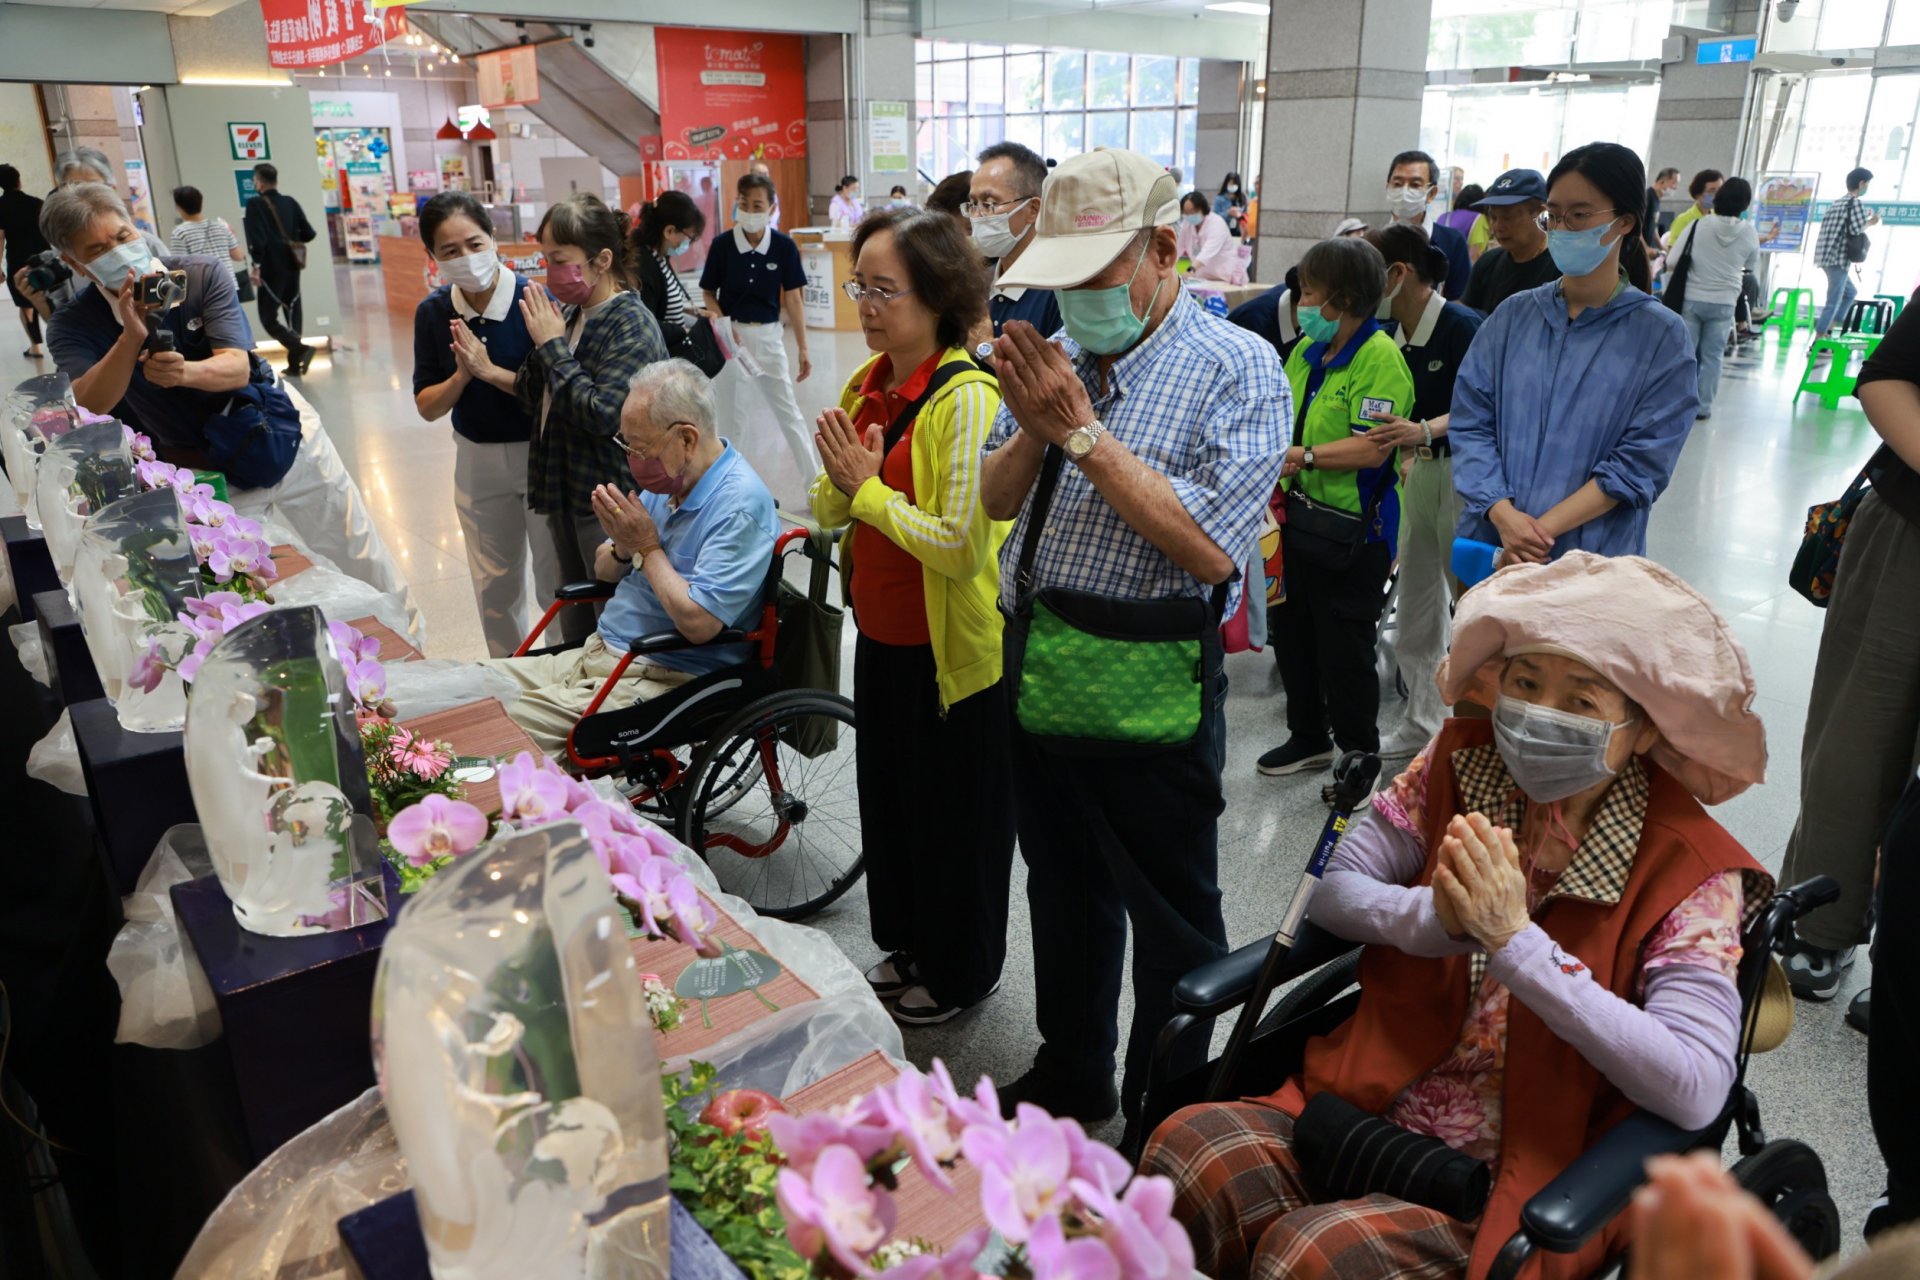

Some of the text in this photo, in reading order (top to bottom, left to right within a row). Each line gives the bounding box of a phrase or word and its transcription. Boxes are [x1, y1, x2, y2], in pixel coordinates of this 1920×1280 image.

[1877, 206, 1920, 217] 高雄市立
[618, 728, 640, 739] soma
